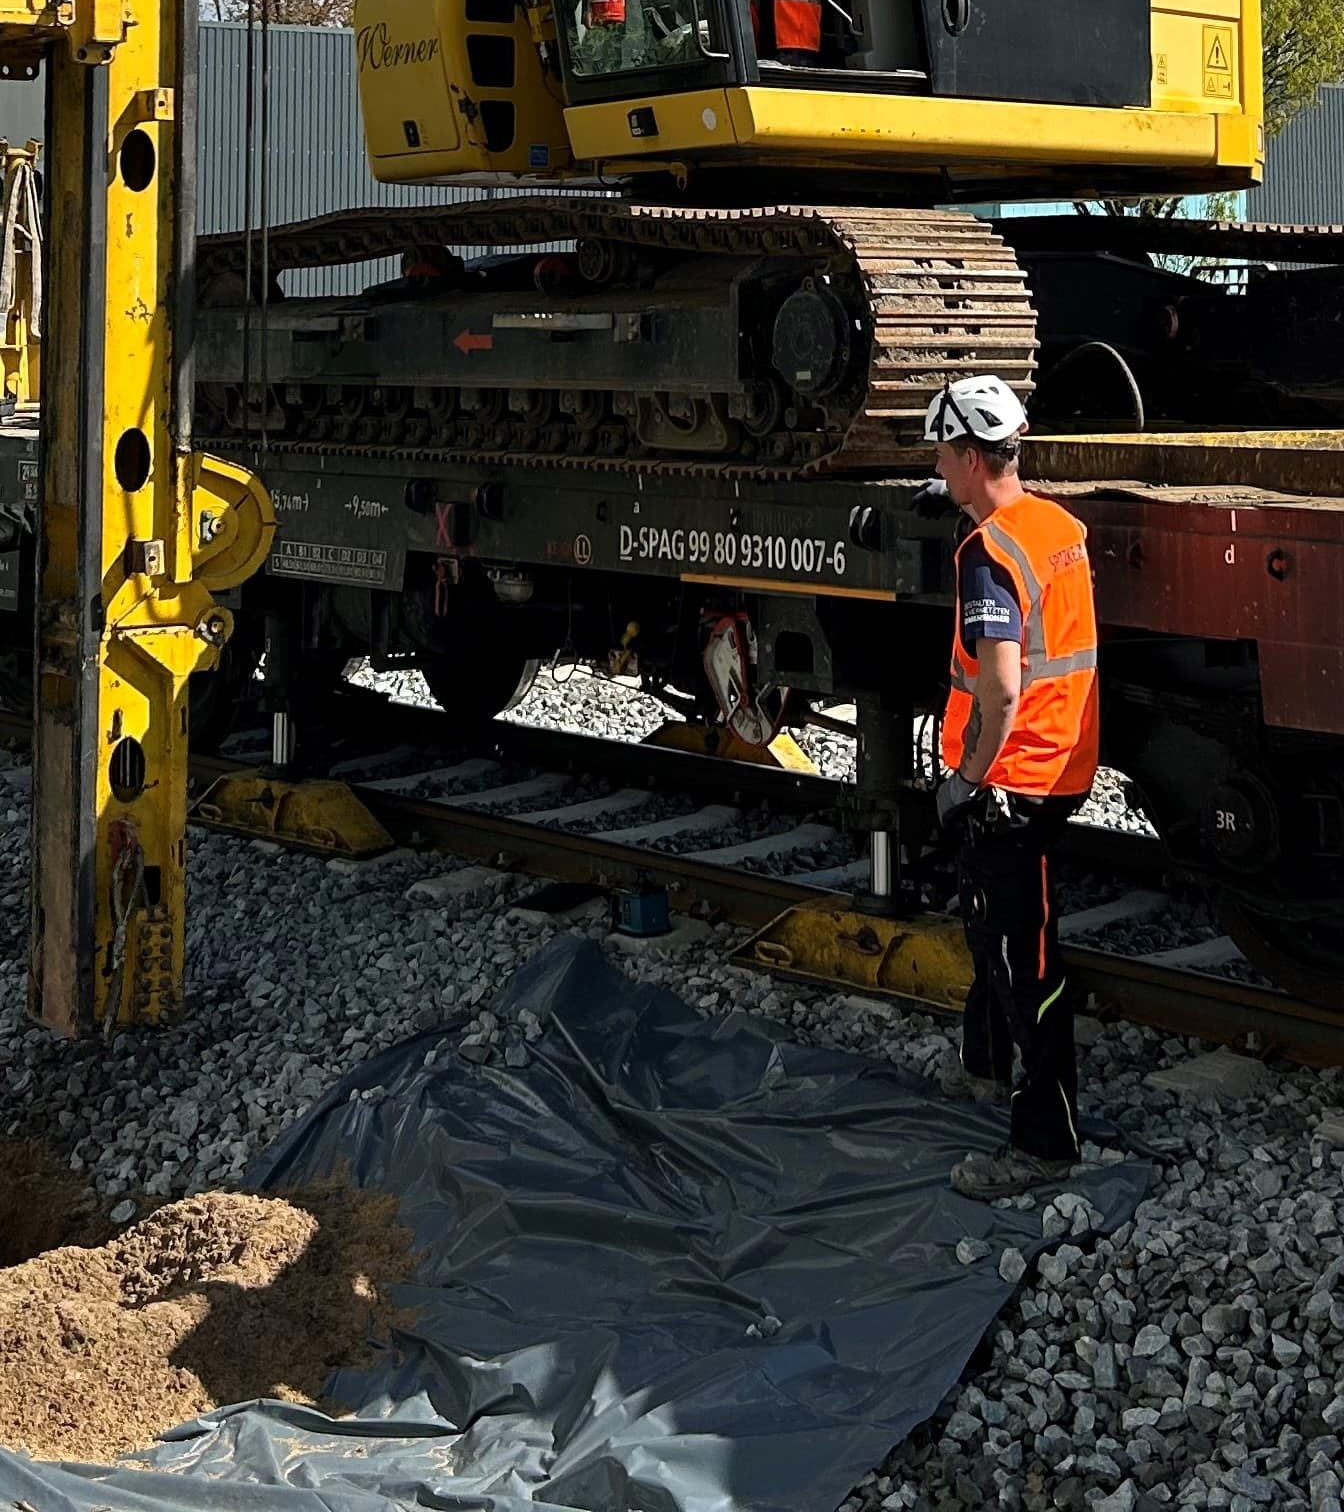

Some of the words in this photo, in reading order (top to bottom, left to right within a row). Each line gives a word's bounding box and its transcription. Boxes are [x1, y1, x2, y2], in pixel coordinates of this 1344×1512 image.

[356, 20, 439, 74] Werner
[633, 501, 640, 513] a
[619, 524, 685, 562] D-SPAG
[688, 530, 710, 563] 99
[713, 532, 737, 566] 80
[740, 534, 786, 570] 9310
[790, 538, 846, 575] 007-6
[1223, 544, 1235, 567] d
[1214, 808, 1237, 833] 3R
